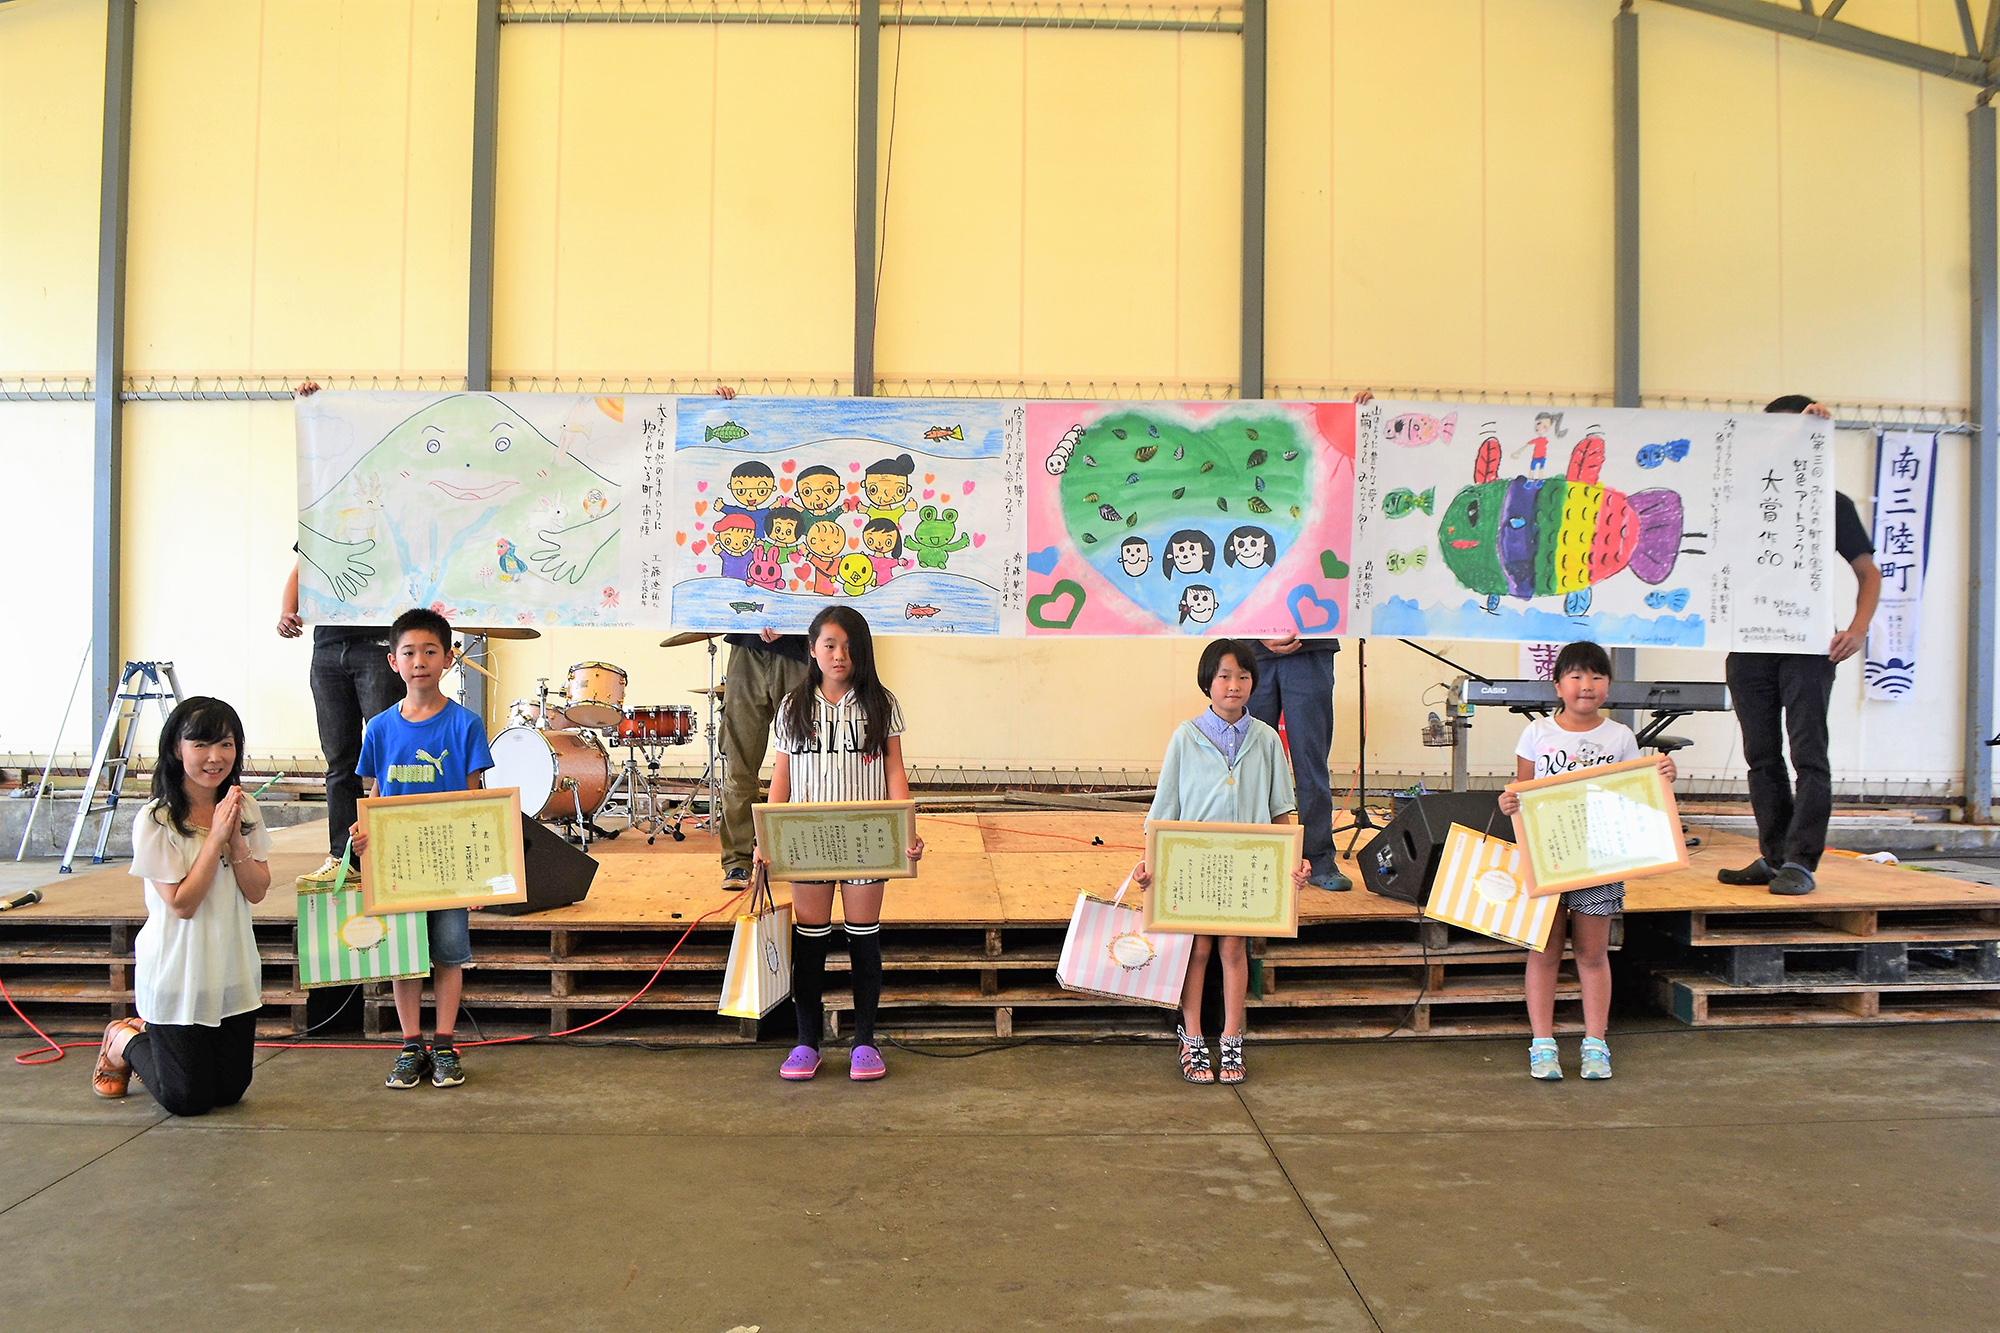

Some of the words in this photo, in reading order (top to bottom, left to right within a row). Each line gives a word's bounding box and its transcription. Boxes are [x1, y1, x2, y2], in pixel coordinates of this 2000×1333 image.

[654, 403, 667, 530] 大きな自然の手のひらに
[1879, 445, 1920, 593] 南三陸町
[387, 764, 436, 783] PUMA
[1537, 749, 1578, 777] We
